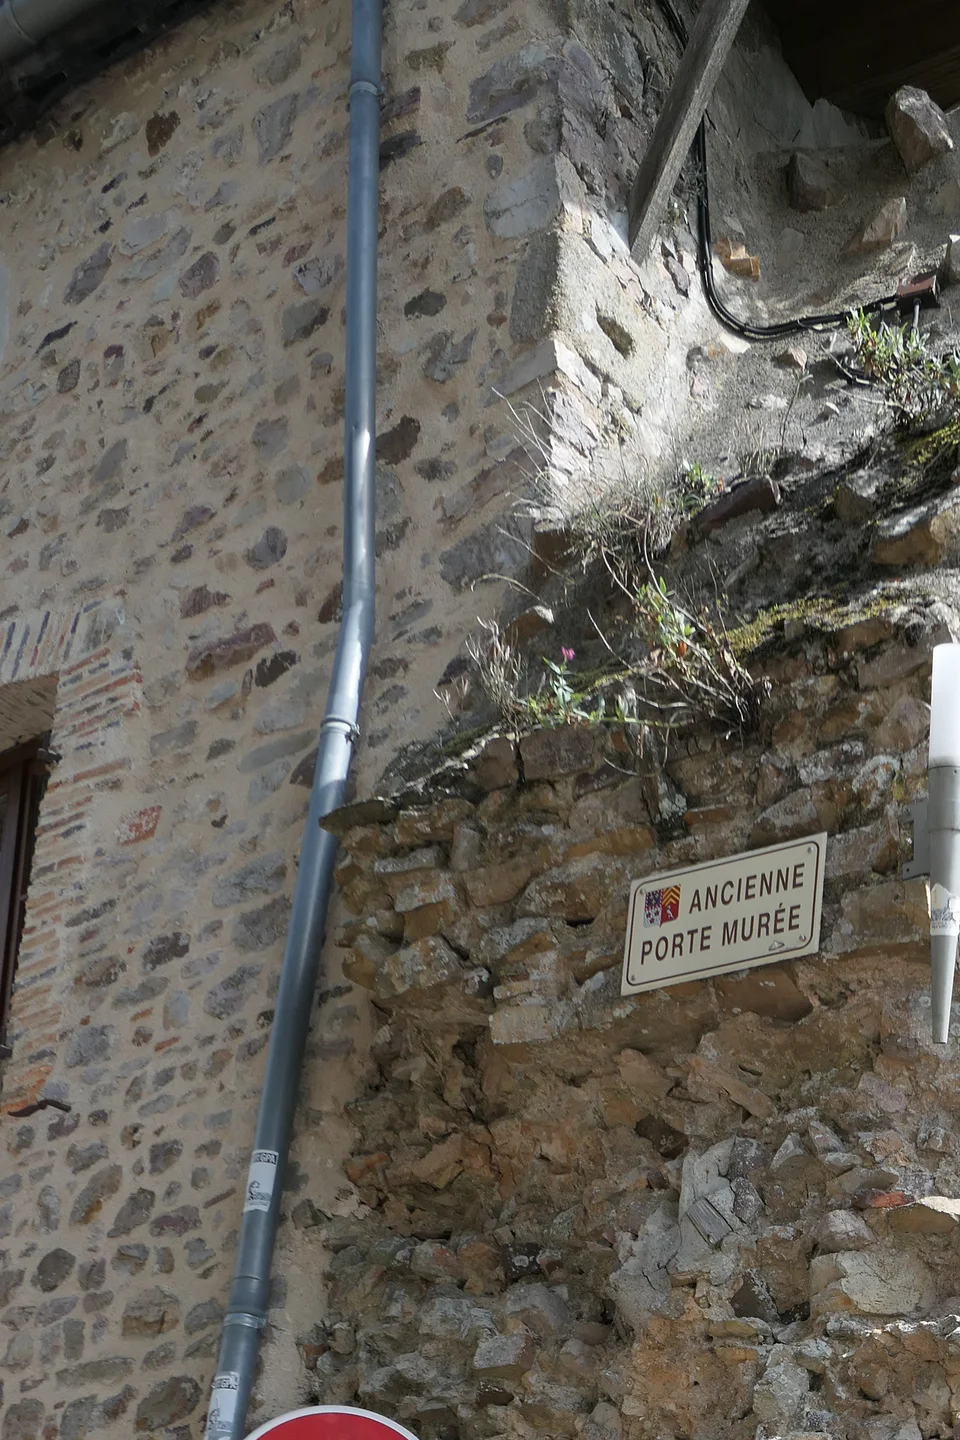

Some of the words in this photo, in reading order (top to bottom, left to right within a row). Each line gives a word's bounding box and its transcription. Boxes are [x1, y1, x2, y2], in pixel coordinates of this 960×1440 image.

[689, 863, 805, 914] ANCIENNE
[641, 925, 713, 965] PORTE
[721, 902, 801, 946] MURÉE
